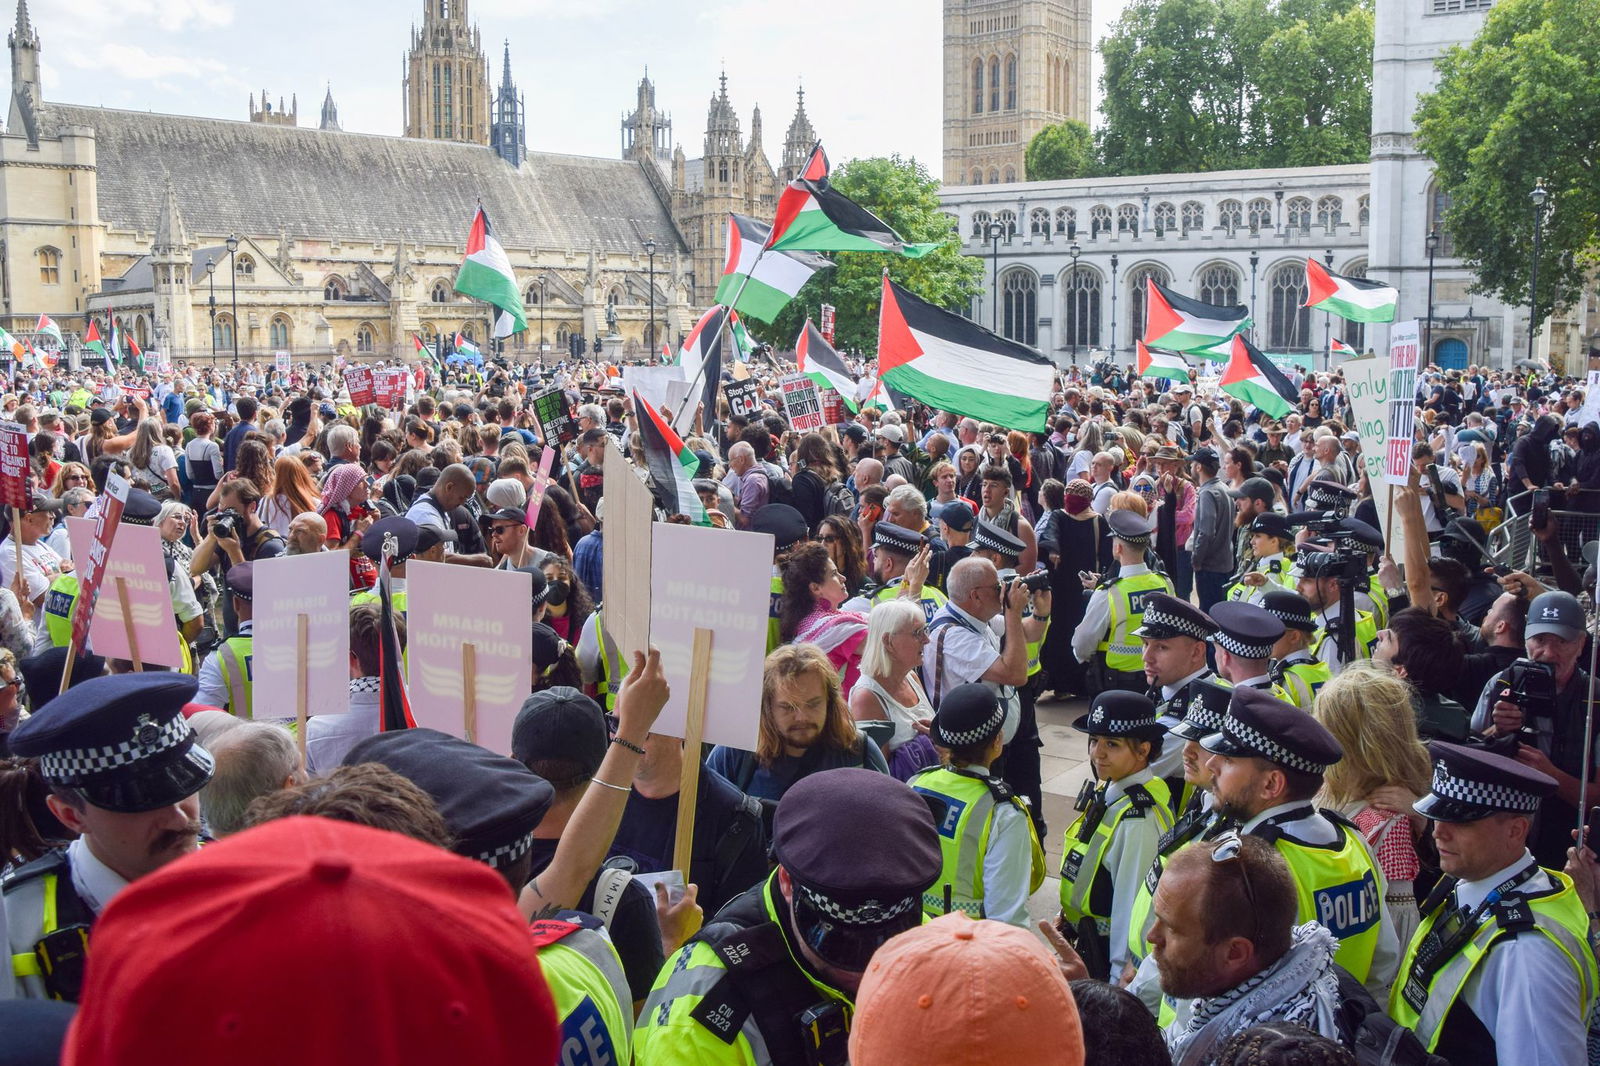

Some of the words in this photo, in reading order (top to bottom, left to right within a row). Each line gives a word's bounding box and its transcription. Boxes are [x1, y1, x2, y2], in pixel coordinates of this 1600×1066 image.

[728, 388, 743, 397] Stop
[1351, 368, 1387, 404] only
[732, 391, 762, 416] GAZ
[785, 390, 805, 404] DEFEND
[788, 400, 809, 417] RIGHT
[809, 399, 819, 412] TO
[543, 415, 570, 431] PALESTINE
[792, 412, 822, 431] PROTEST
[1402, 401, 1413, 438] TO
[547, 436, 559, 447] FREE
[1386, 439, 1411, 476] TEST
[1497, 879, 1517, 894] FICER
[1318, 880, 1379, 930] POLICE
[722, 945, 742, 965] 2323
[736, 943, 751, 957] CN
[718, 1003, 734, 1018] CN
[706, 1010, 731, 1032] 2323
